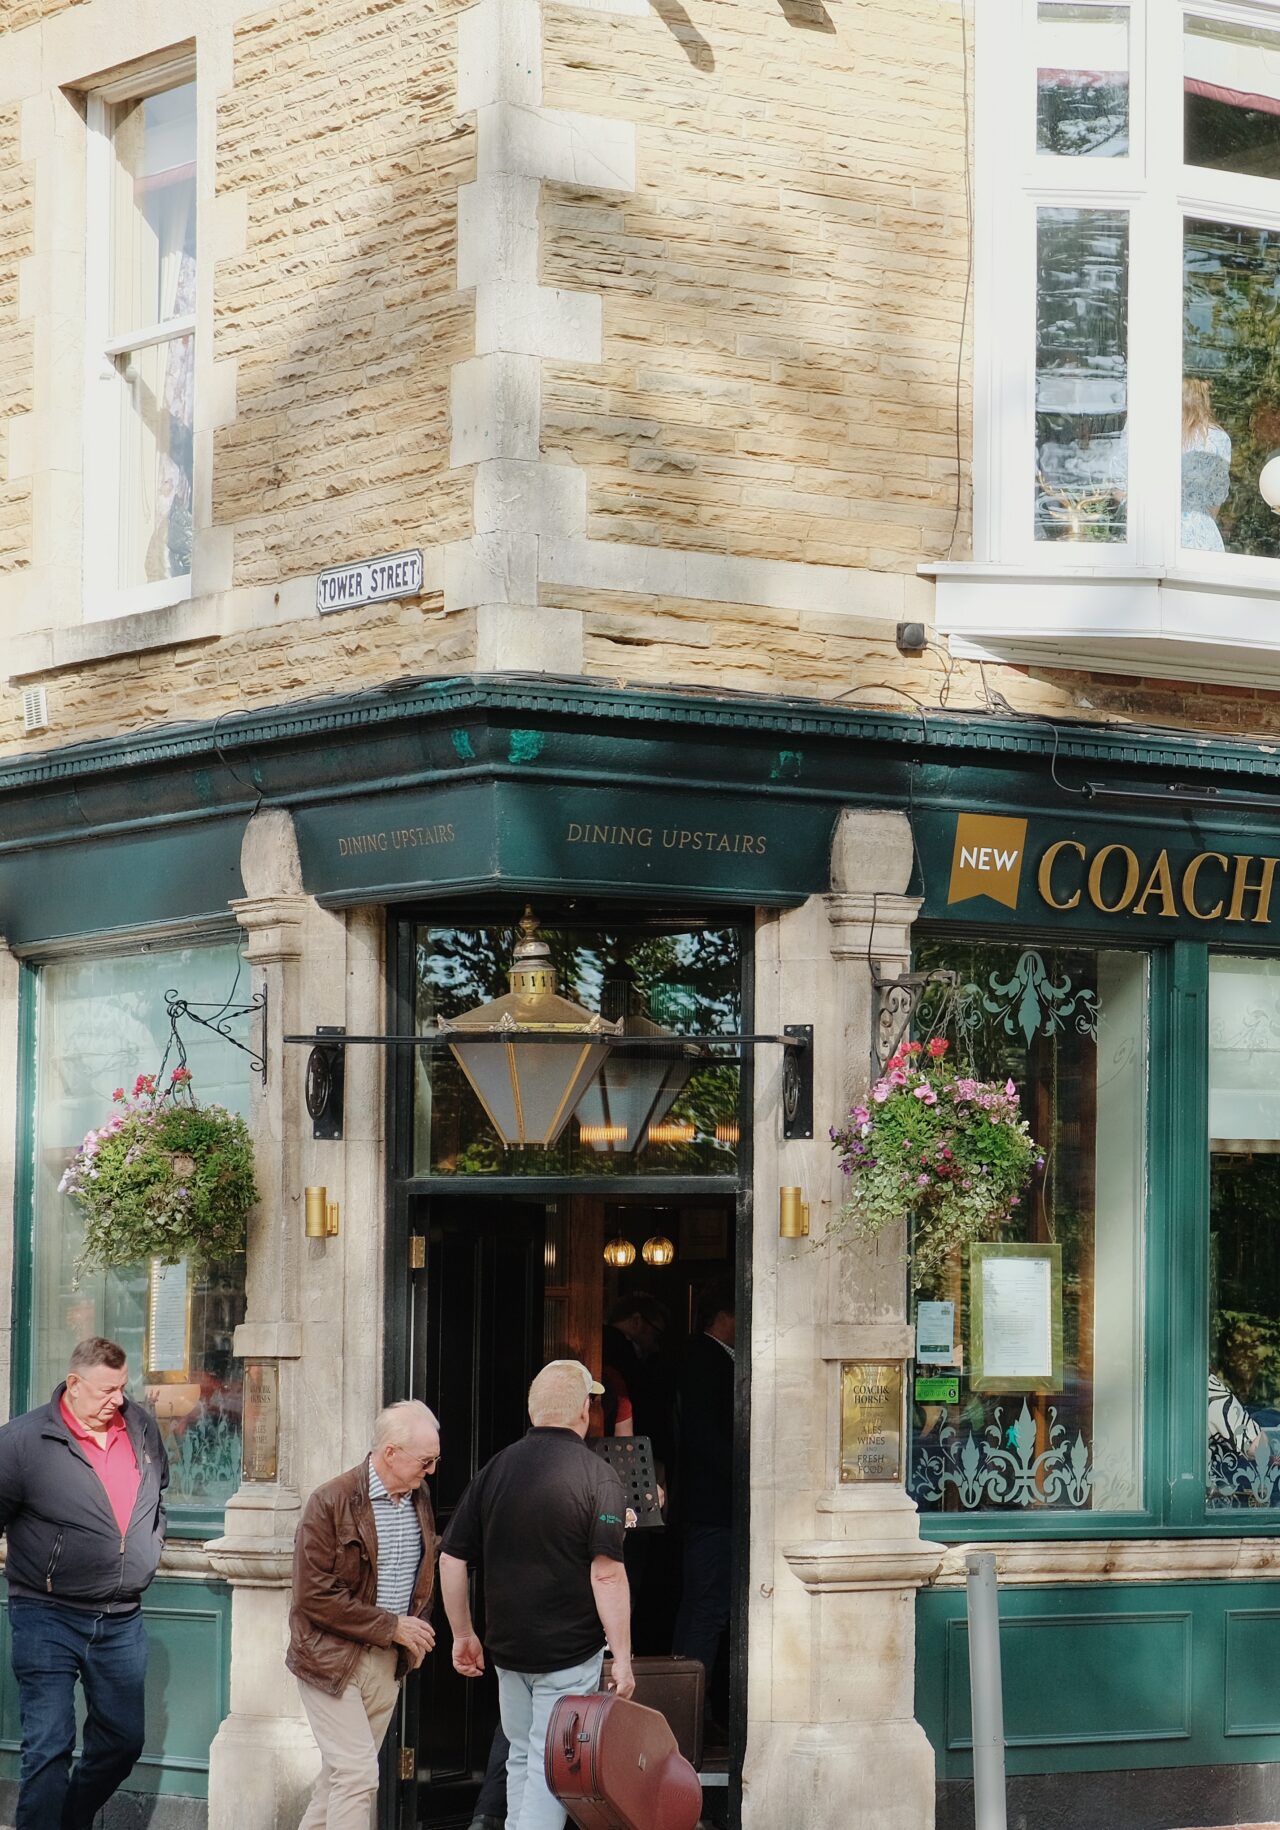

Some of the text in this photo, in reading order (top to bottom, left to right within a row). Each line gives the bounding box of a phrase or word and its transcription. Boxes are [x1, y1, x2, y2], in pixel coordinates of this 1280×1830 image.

[321, 559, 417, 602] TOWER STREET
[338, 823, 455, 856] DINING UPSTAIRS
[567, 823, 767, 855] DINING UPSTAIRS
[959, 846, 1018, 872] NEW
[1037, 839, 1280, 924] COACH
[854, 1394, 890, 1404] HORSES
[857, 1436, 886, 1446] WINES
[857, 1454, 885, 1463] FRESH
[858, 1465, 884, 1474] FOOD
